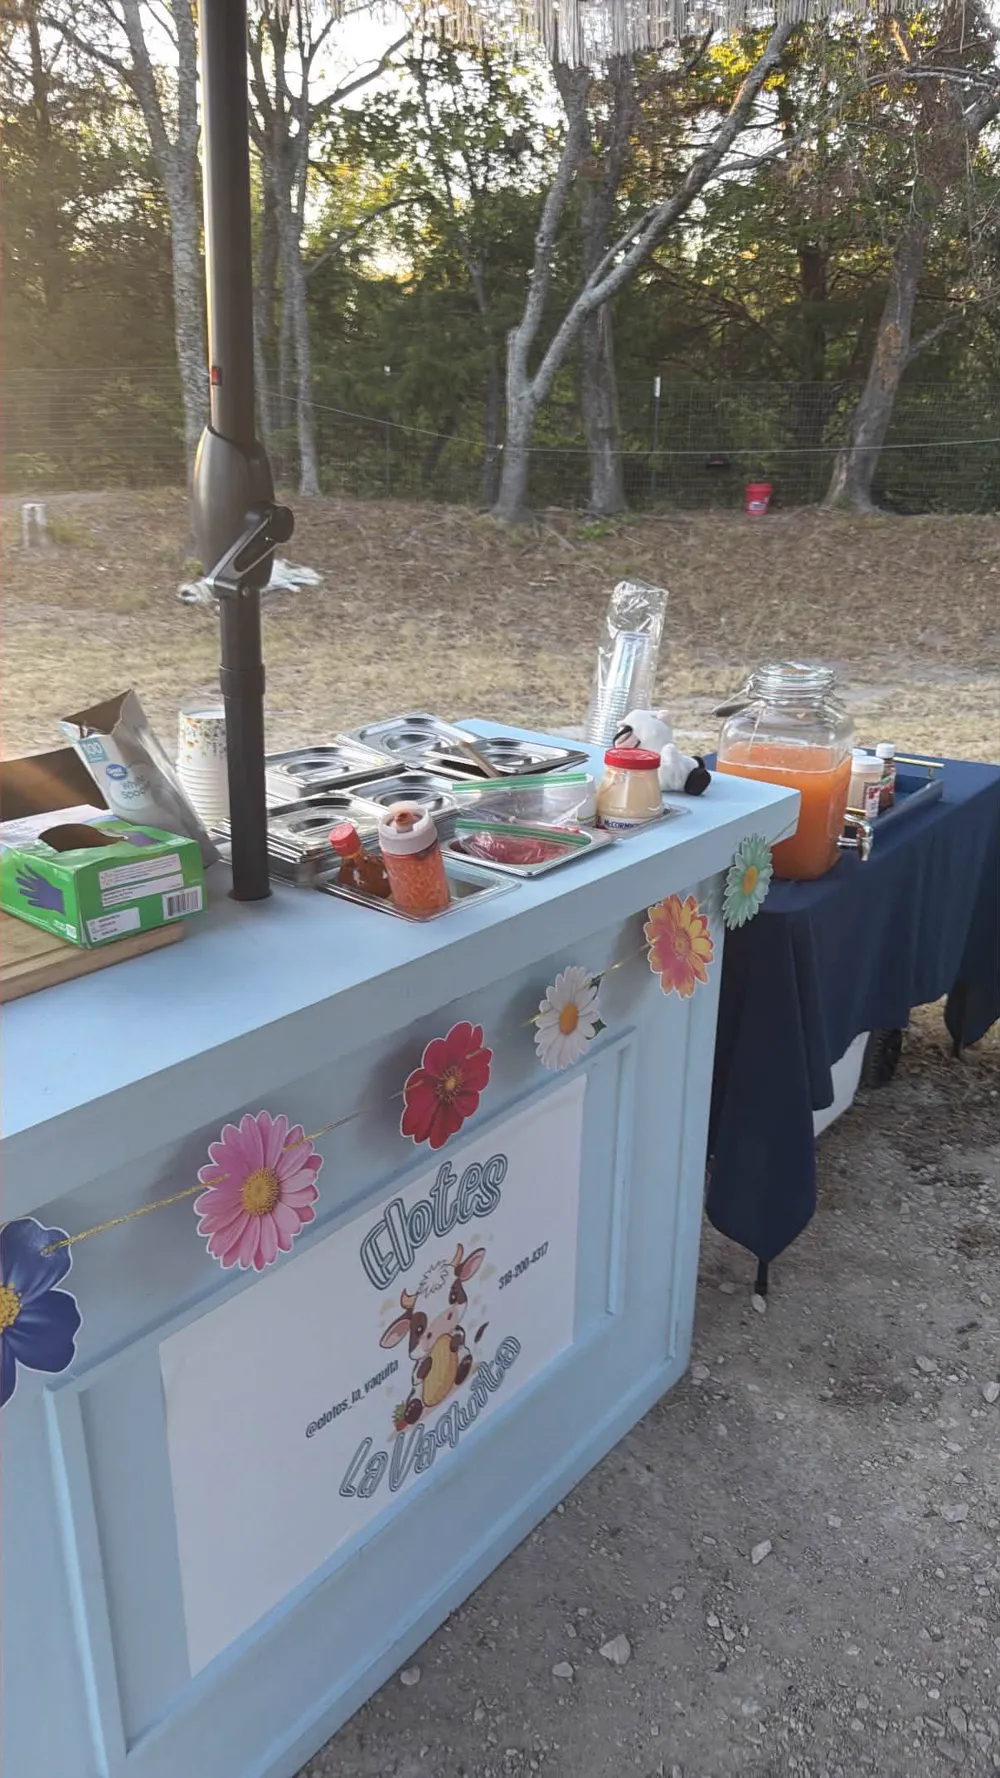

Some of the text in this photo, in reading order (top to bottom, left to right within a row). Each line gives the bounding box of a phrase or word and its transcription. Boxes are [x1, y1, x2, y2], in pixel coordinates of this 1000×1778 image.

[360, 1153, 508, 1291] Elotes
[339, 1336, 521, 1498] La Vaquita
